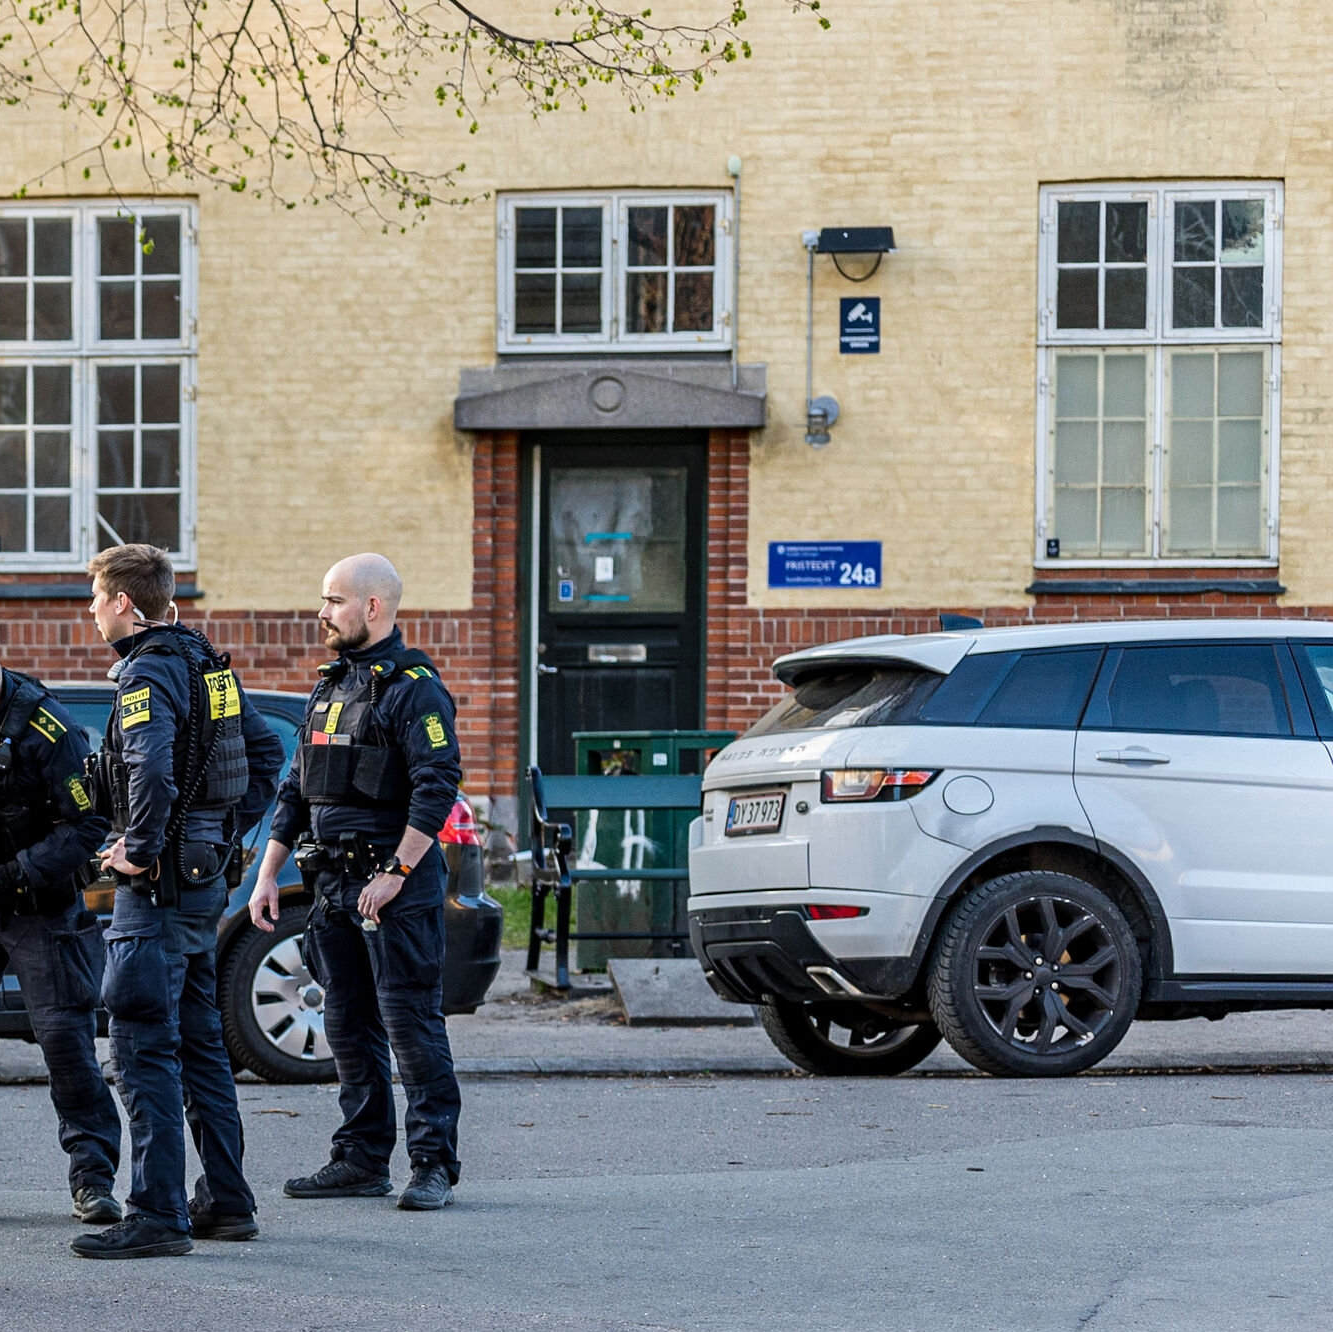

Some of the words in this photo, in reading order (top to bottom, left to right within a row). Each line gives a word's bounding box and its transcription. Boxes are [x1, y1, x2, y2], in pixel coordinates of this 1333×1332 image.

[839, 562, 876, 585] 24a
[733, 803, 748, 825] DY
[746, 801, 761, 824] 37
[760, 799, 780, 822] 973
